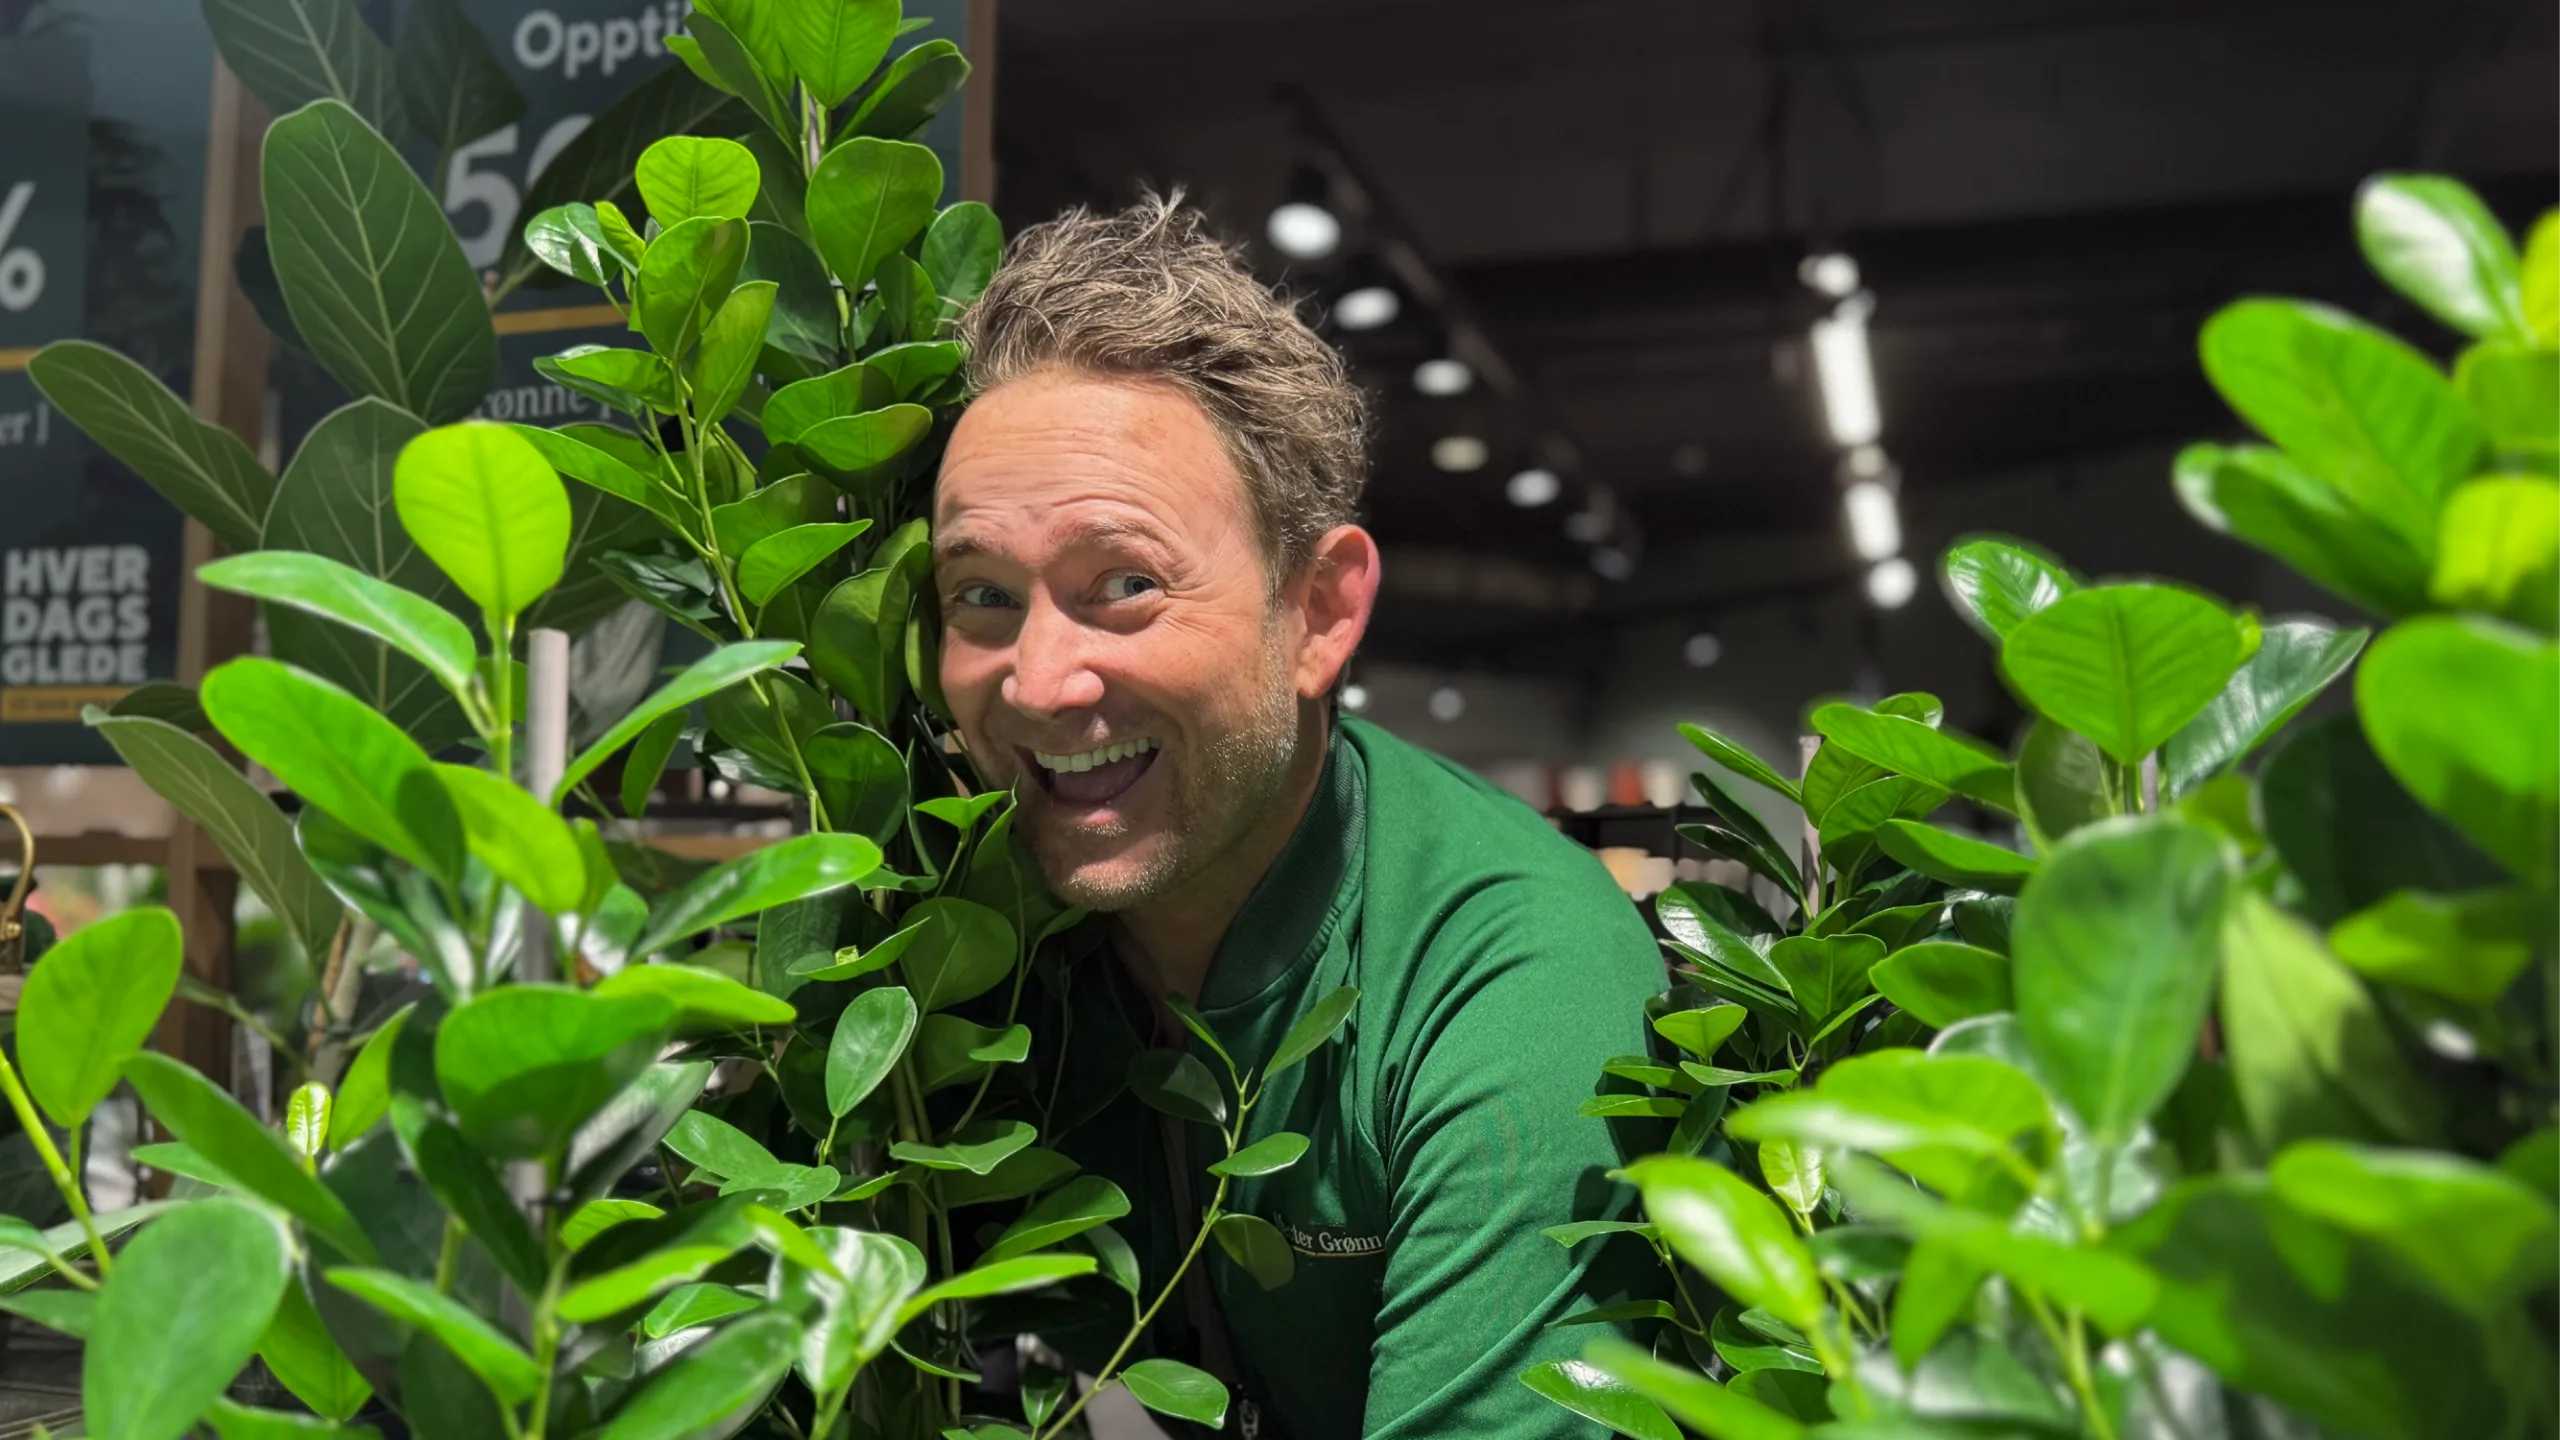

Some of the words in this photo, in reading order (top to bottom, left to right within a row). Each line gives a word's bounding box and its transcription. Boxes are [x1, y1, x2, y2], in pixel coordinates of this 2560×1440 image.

[6, 545, 149, 594] HVER
[4, 595, 149, 642] DAGS
[1, 643, 147, 685] GLEDE
[1318, 1231, 1382, 1253] Grønn
